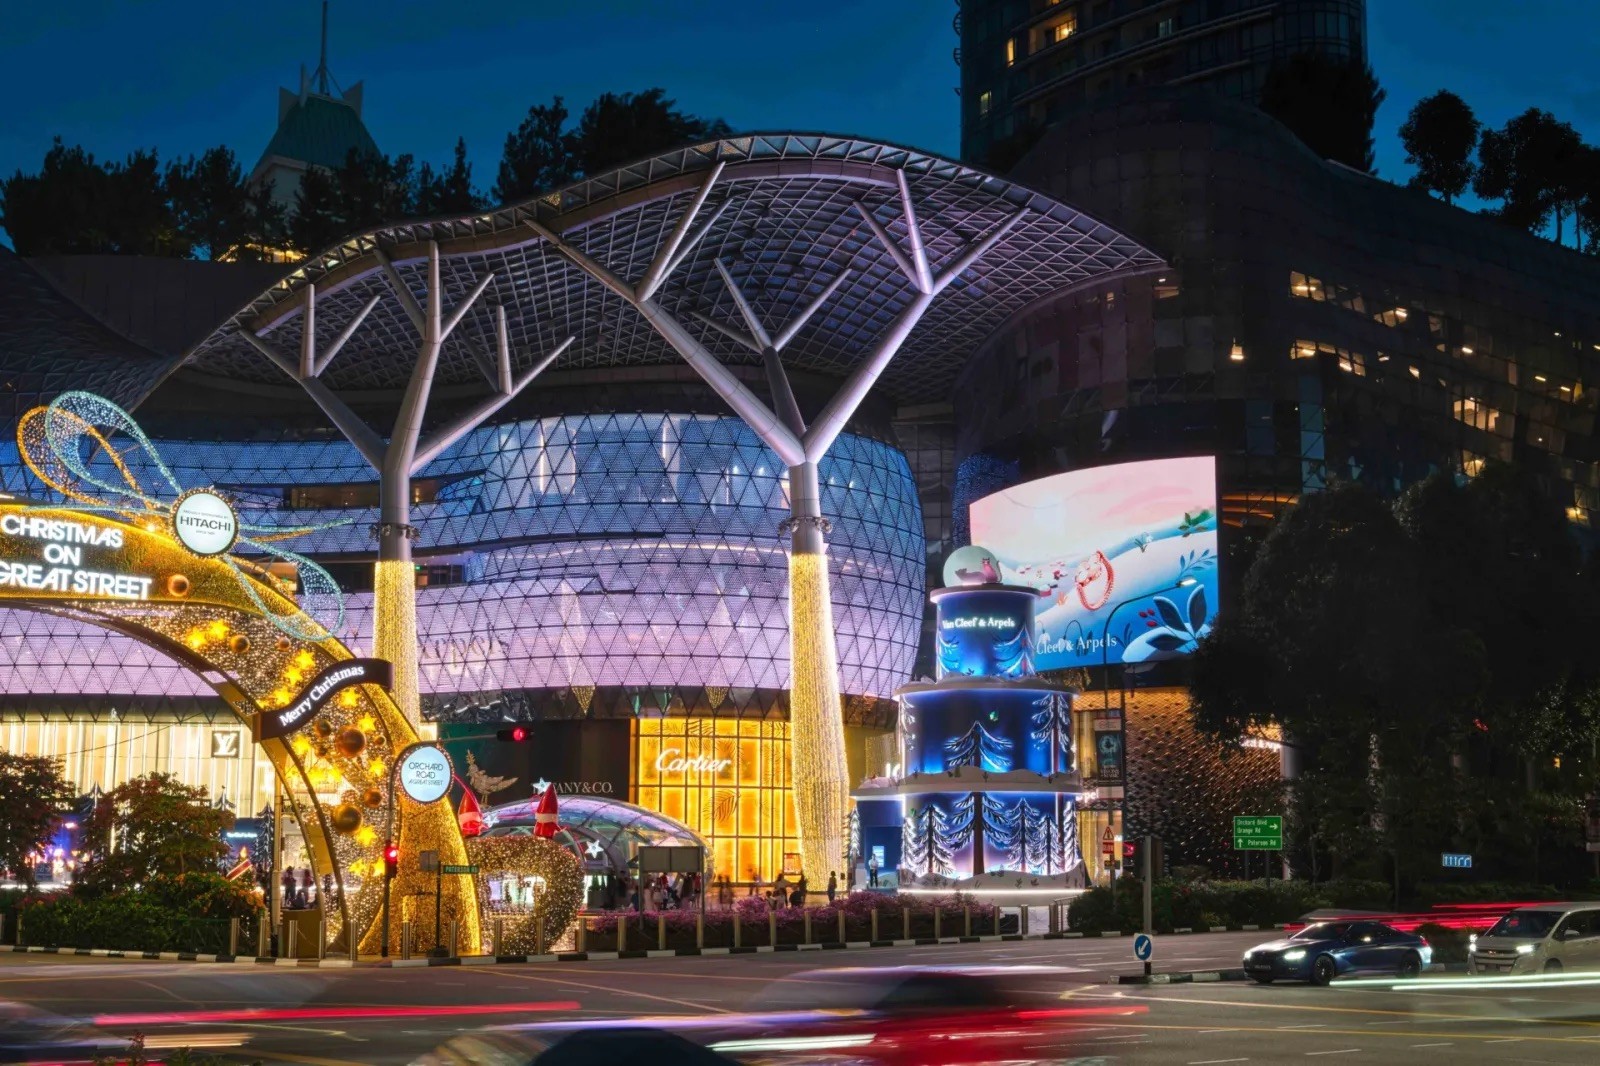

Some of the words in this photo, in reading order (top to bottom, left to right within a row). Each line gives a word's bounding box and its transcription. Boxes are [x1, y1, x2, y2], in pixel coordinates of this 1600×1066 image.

[0, 514, 123, 548] CHRISTMAS
[180, 515, 231, 531] HITACHI
[43, 543, 81, 566] ON
[73, 570, 153, 600] STREET
[942, 620, 954, 629] Van
[954, 616, 978, 628] Cleef
[978, 619, 986, 627] &
[987, 617, 1015, 630] Arpels
[279, 698, 312, 727] Merry
[309, 666, 365, 701] Christmas
[408, 762, 444, 771] ORCHARD
[655, 748, 732, 772] Cartier
[415, 771, 436, 779] ROAD
